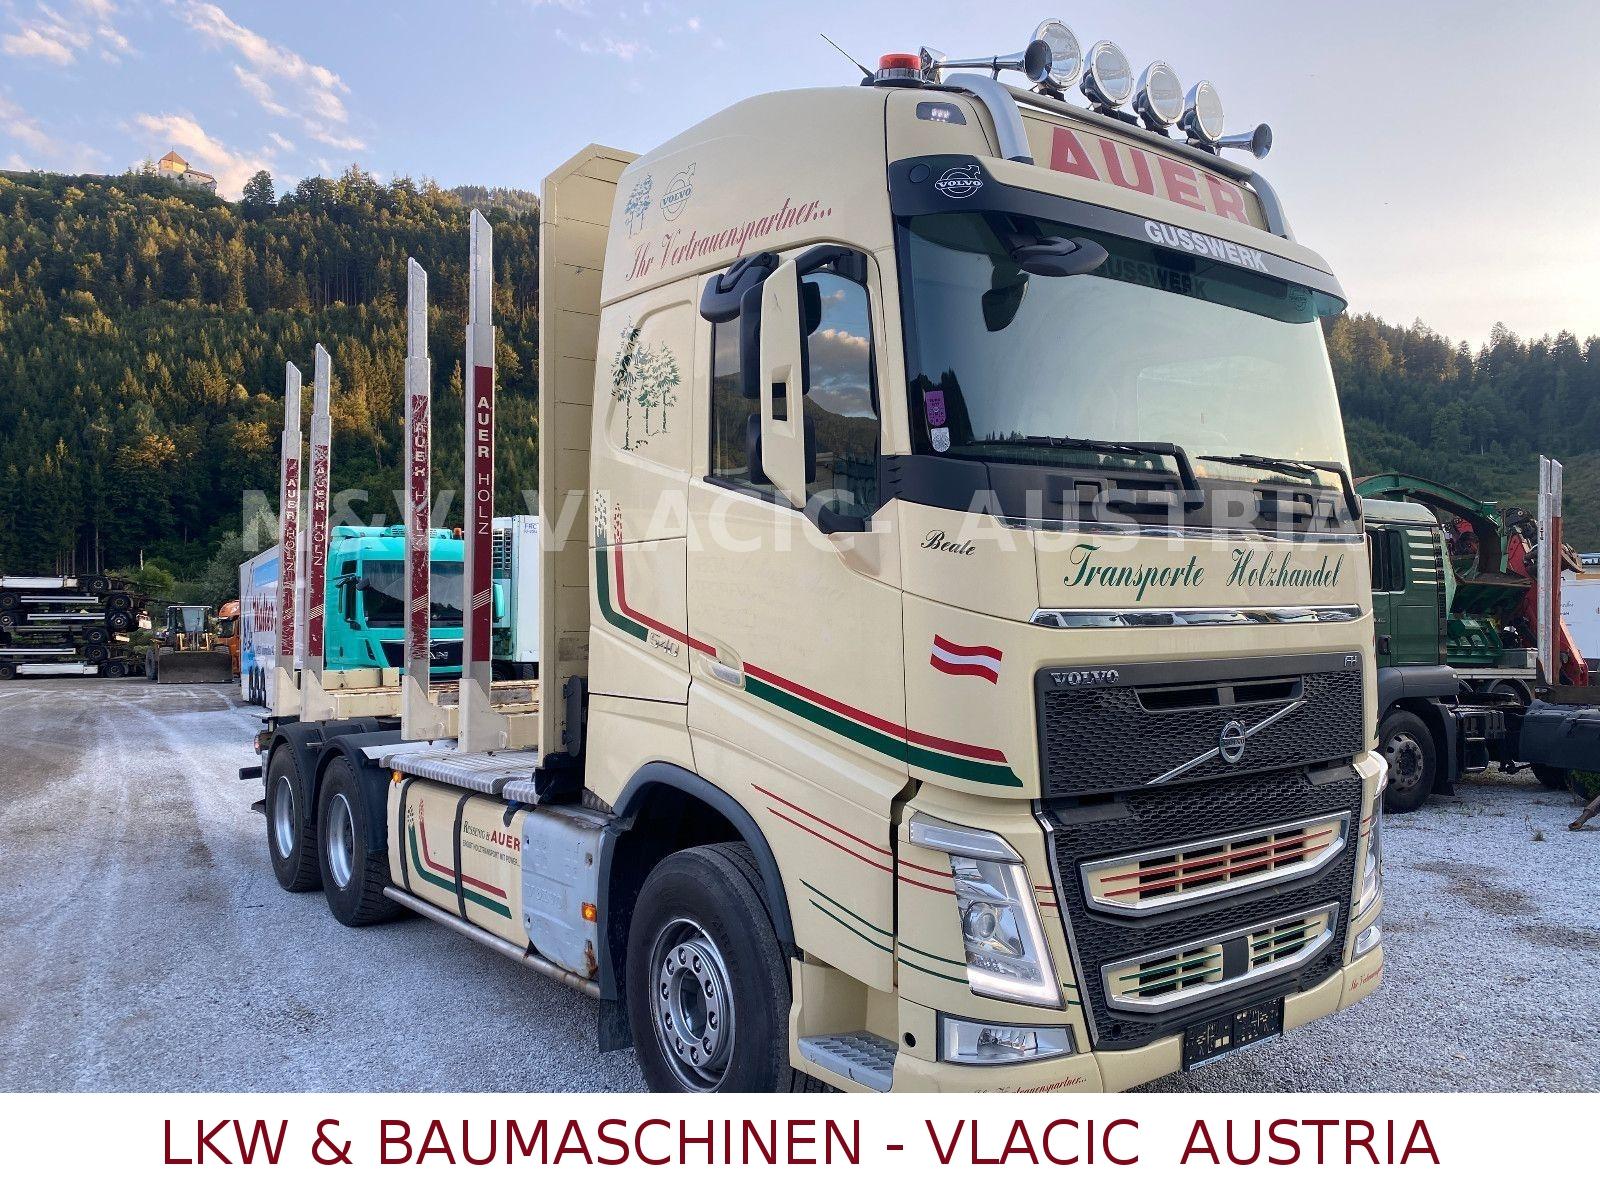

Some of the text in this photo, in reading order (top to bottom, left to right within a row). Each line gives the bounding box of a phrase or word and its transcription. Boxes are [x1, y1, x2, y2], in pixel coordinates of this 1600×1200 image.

[662, 186, 692, 206] VOLVO
[937, 180, 982, 188] VOLVO
[1049, 126, 1250, 225] AUER
[625, 240, 655, 281] Ihr
[1143, 219, 1270, 273] GUSSWERK
[477, 396, 490, 535] AUER HOLZ
[286, 478, 297, 520] AUER
[1063, 543, 1344, 601] Transporte Holzhandel
[1050, 669, 1120, 686] VOLVO
[491, 830, 521, 851] AUER
